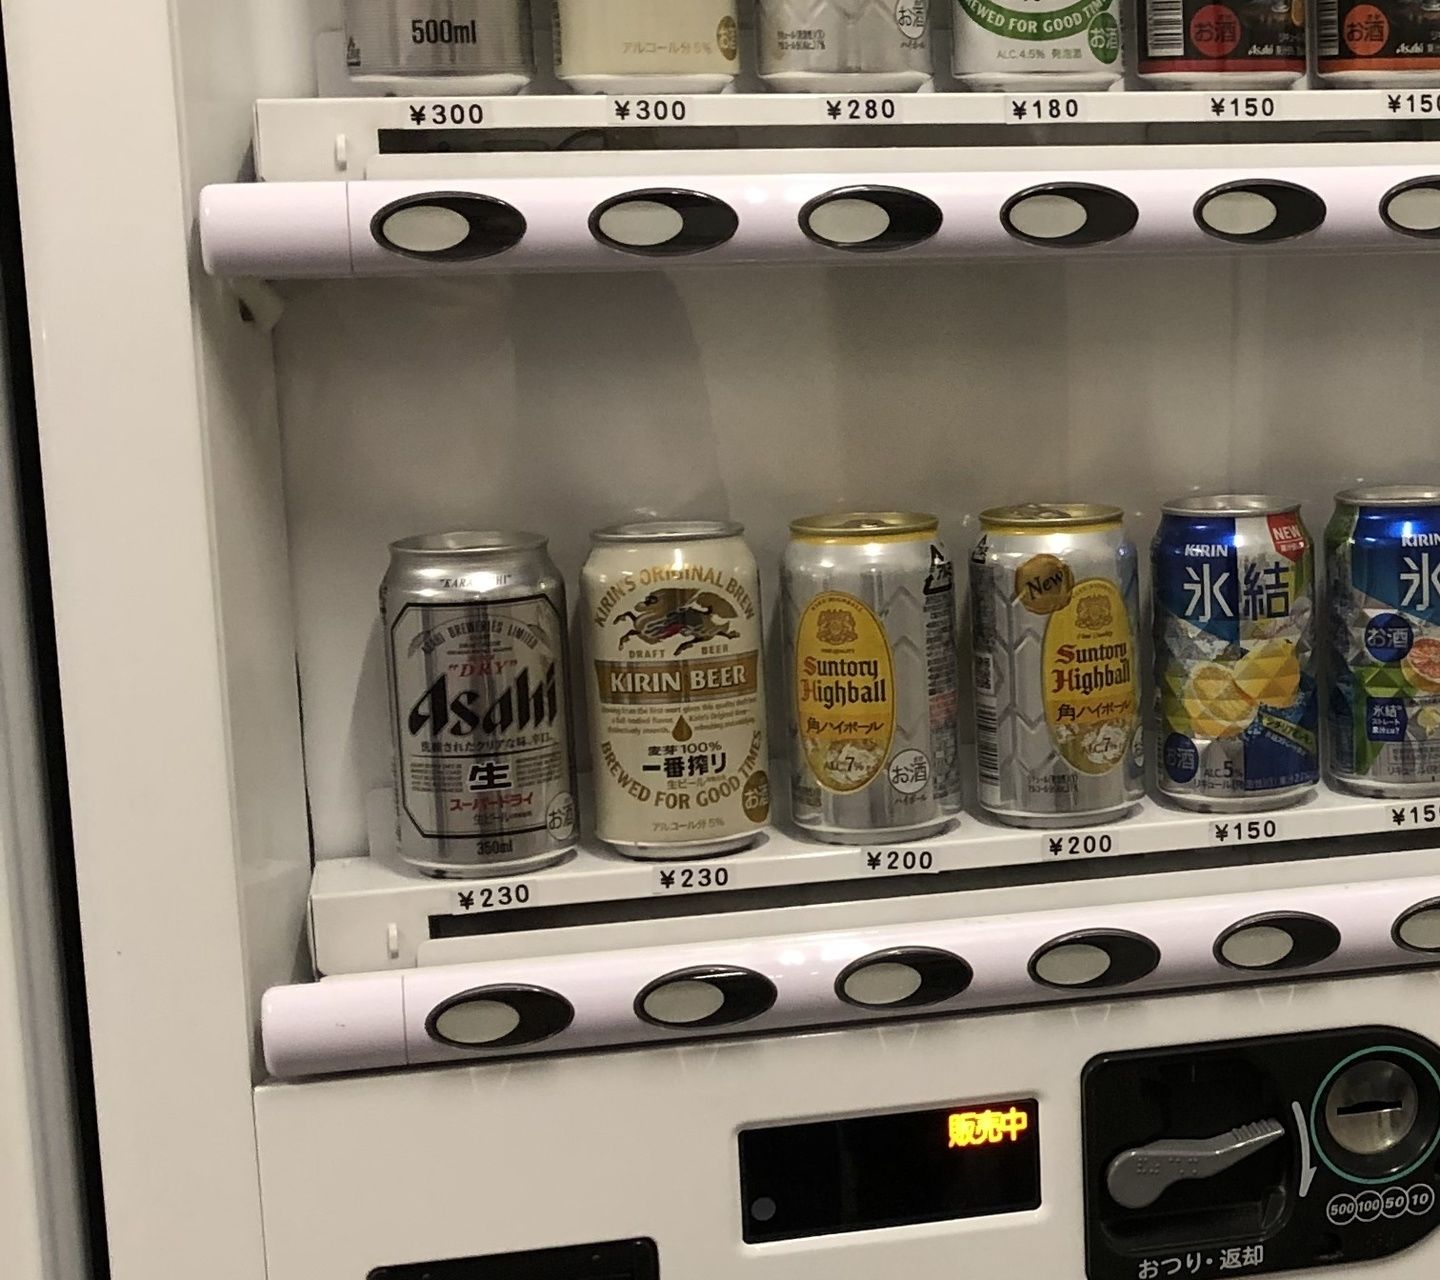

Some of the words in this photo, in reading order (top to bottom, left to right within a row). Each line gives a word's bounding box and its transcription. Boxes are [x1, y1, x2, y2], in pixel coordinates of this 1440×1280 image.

[411, 19, 477, 45] 500ml
[1008, 18, 1038, 33] FOR
[1043, 12, 1083, 33] GOOD
[1347, 21, 1385, 43] お酒
[409, 103, 484, 126] ¥300
[614, 100, 686, 121] ¥300
[826, 99, 895, 121] ¥280
[1012, 98, 1079, 121] ¥180
[1210, 97, 1275, 117] ¥150
[1272, 525, 1302, 541] NEW
[1184, 543, 1229, 558] KIRIN
[594, 574, 636, 628] KIRIN'S
[639, 565, 724, 589] ORIGINAL
[725, 578, 755, 620] BREW
[1026, 569, 1065, 601] New
[1183, 561, 1290, 623] 氷結
[507, 623, 539, 650] LIMITED
[1366, 627, 1409, 649] お酒
[628, 649, 666, 659] DRAFT
[701, 643, 729, 655] BEER
[1054, 641, 1128, 666] Suntory
[610, 671, 682, 693] KIRIN
[689, 664, 747, 690] BEER
[803, 655, 879, 681] Suntory
[1051, 658, 1130, 696] Highball
[408, 662, 558, 736] Asahi
[800, 678, 887, 711] Highball
[1056, 699, 1130, 722] 角ハイボール
[806, 717, 885, 735] 角ハイボール
[648, 741, 723, 757] 麦芽100%
[470, 762, 512, 791] 生
[601, 741, 652, 803] BREWED
[654, 790, 691, 810] FOR
[696, 775, 741, 808] GOOD
[737, 729, 763, 778] TIMES
[642, 752, 728, 779] 一番搾り
[891, 763, 928, 785] お酒
[450, 792, 534, 812] スーパードライ
[1215, 820, 1277, 842] ¥150
[476, 839, 513, 856] 350ml
[1049, 834, 1112, 856] ¥200
[867, 851, 933, 871] ¥200
[660, 867, 729, 889] ¥230
[458, 884, 530, 911] ¥230
[948, 1106, 1028, 1148] 販売中
[1329, 1203, 1355, 1217] 500
[1358, 1198, 1381, 1213] 100
[1384, 1195, 1405, 1210] 50
[1412, 1192, 1430, 1206] 10
[1138, 1245, 1265, 1280] おつり・返却
